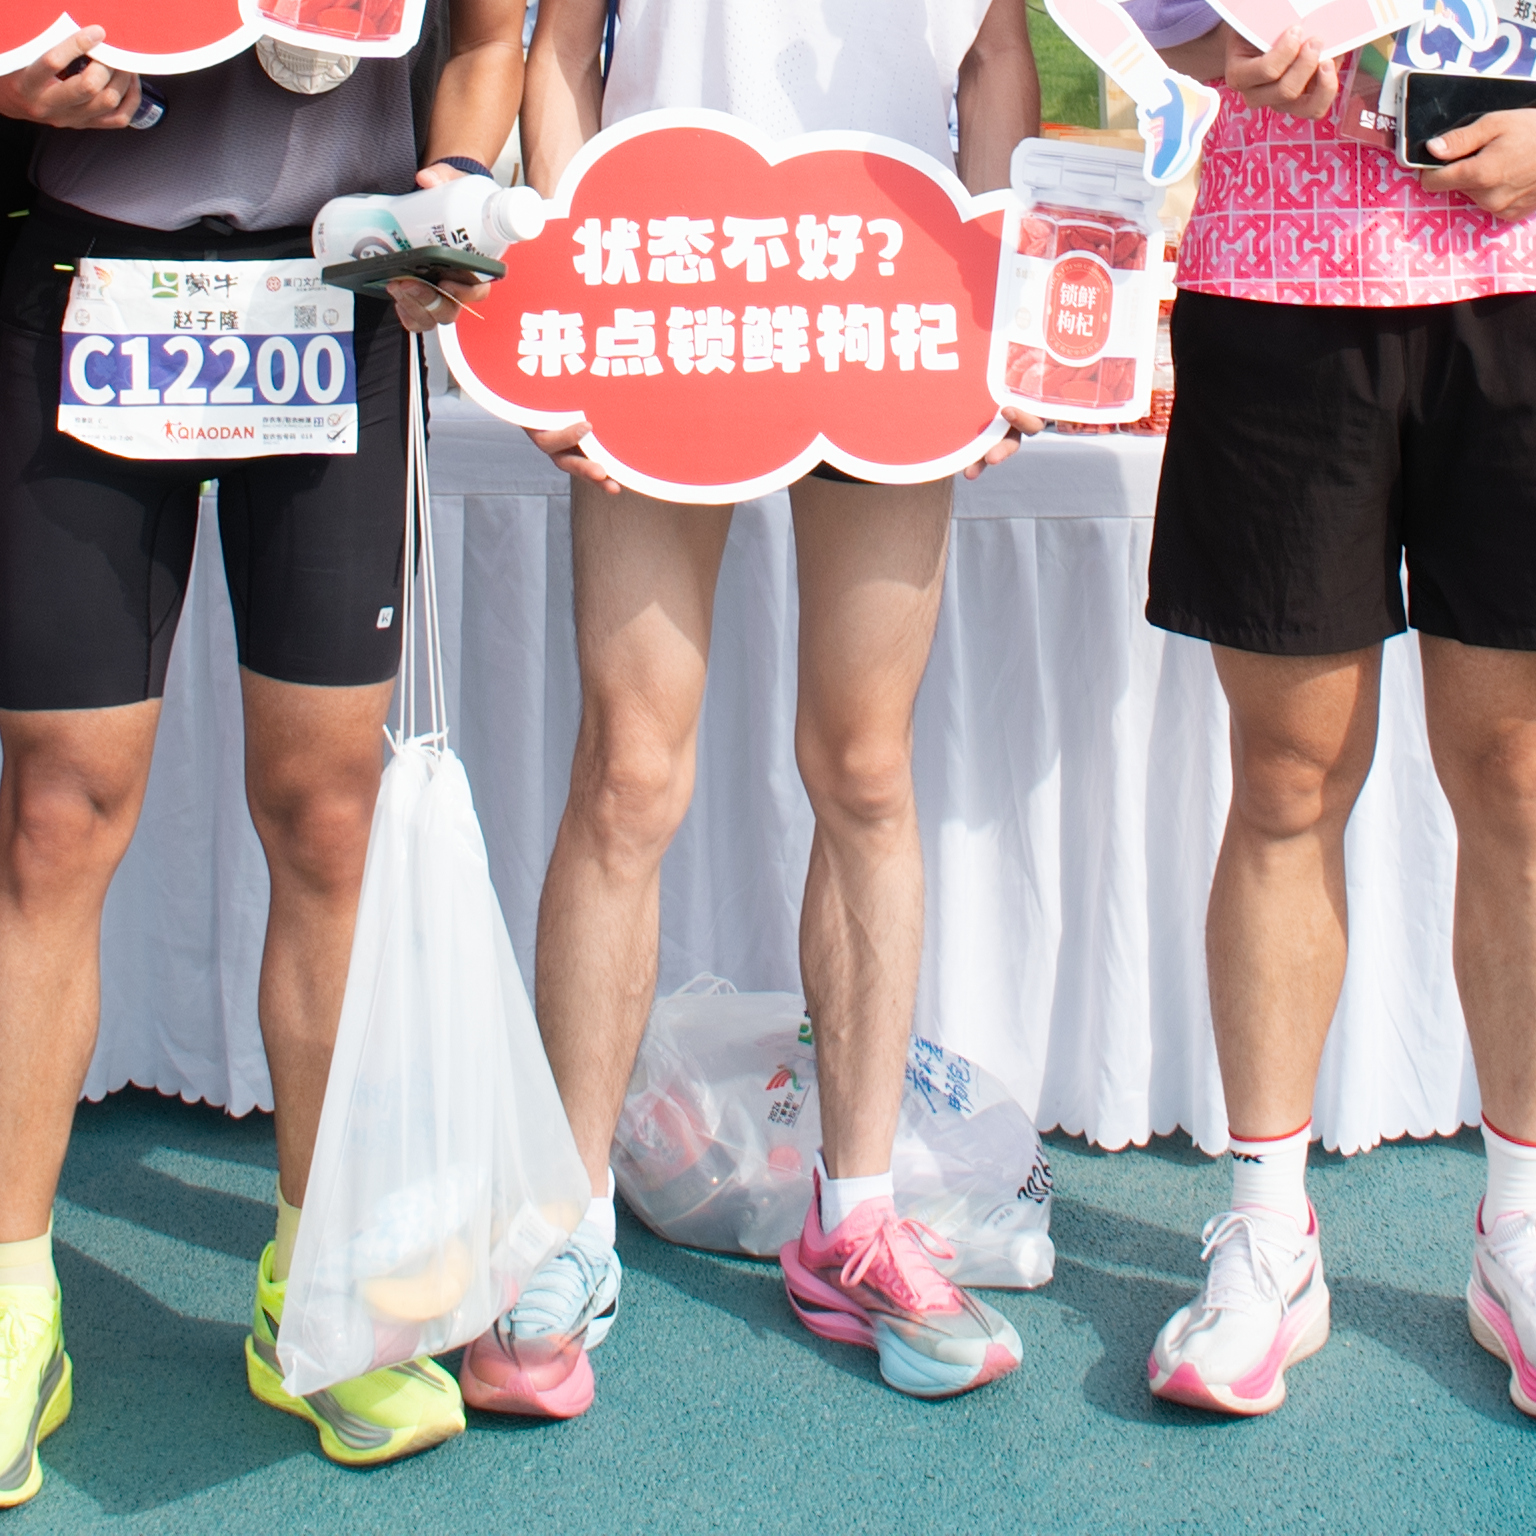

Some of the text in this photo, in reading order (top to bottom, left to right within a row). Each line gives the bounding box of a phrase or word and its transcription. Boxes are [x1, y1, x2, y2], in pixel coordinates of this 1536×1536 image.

[570, 214, 904, 286] 状态不好?
[185, 272, 239, 298] 蒙牛
[1059, 282, 1097, 311] 锁鲜
[172, 310, 240, 331] 赵子隆
[1056, 309, 1094, 337] 枸杞
[517, 303, 961, 378] 来点锁鲜枸杞
[68, 334, 347, 405] C12200
[178, 425, 255, 440] QIAODAN
